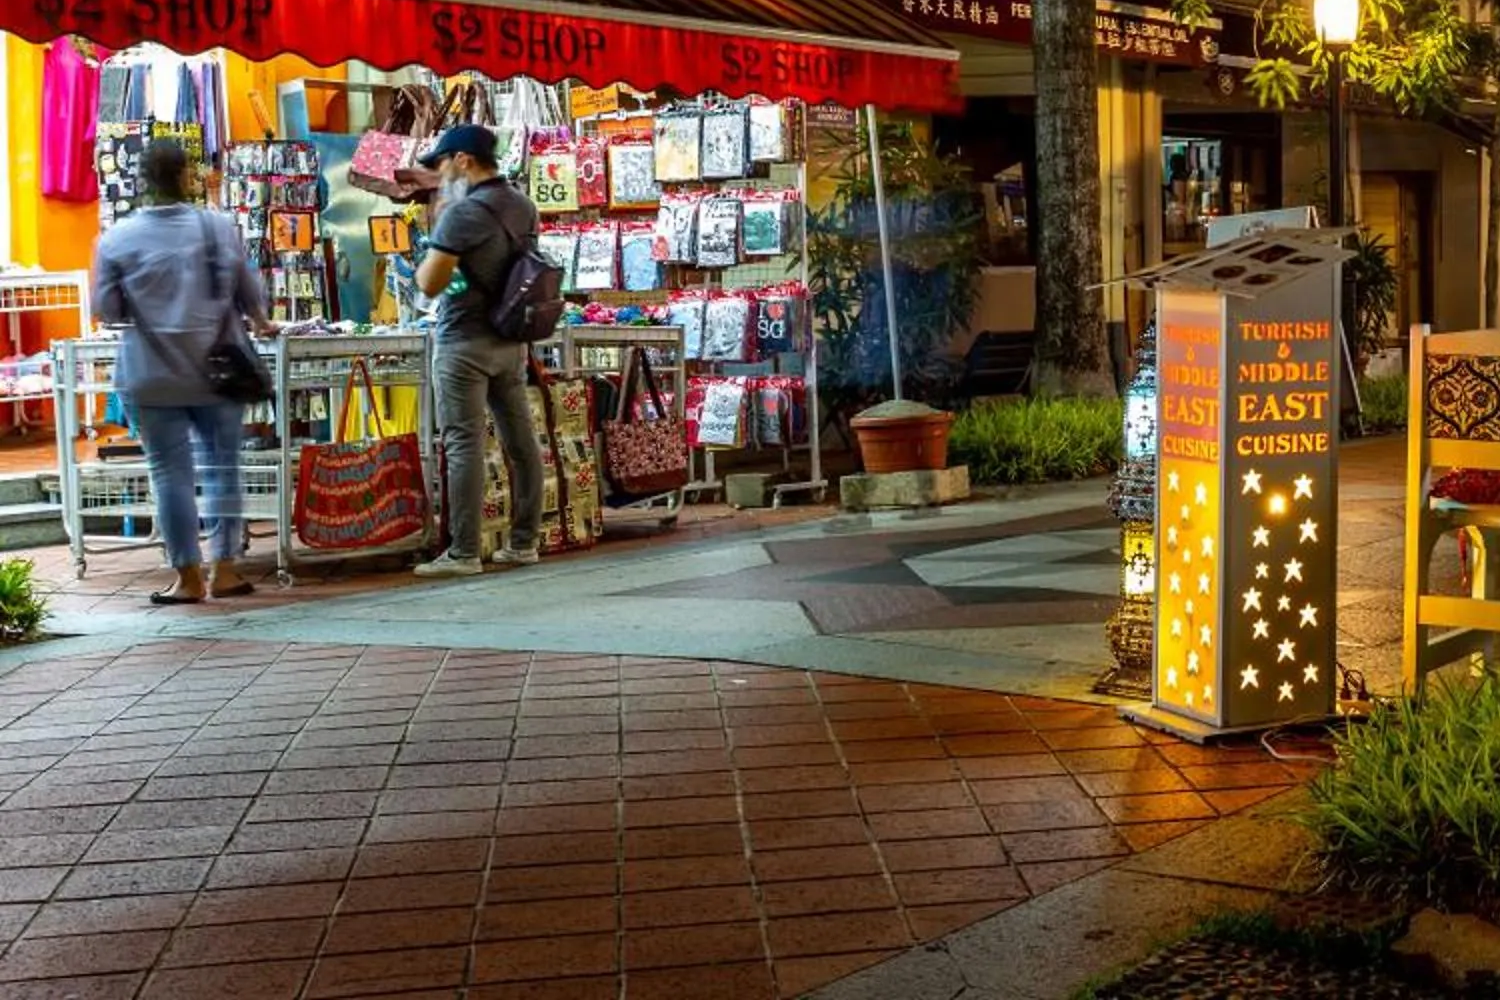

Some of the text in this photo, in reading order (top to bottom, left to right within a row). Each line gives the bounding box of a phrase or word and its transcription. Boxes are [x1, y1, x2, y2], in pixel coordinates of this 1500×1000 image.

[431, 11, 605, 66] $2 SHOP
[721, 41, 853, 90] $2 SHOP
[535, 183, 568, 203] SG
[757, 320, 785, 339] SG
[1239, 321, 1330, 341] TURKISH
[1238, 361, 1329, 384] MIDDLE
[1163, 395, 1220, 427] EAST
[1238, 391, 1329, 424] EAST
[1163, 434, 1220, 462] CUISINE
[1237, 432, 1329, 456] CUISINE
